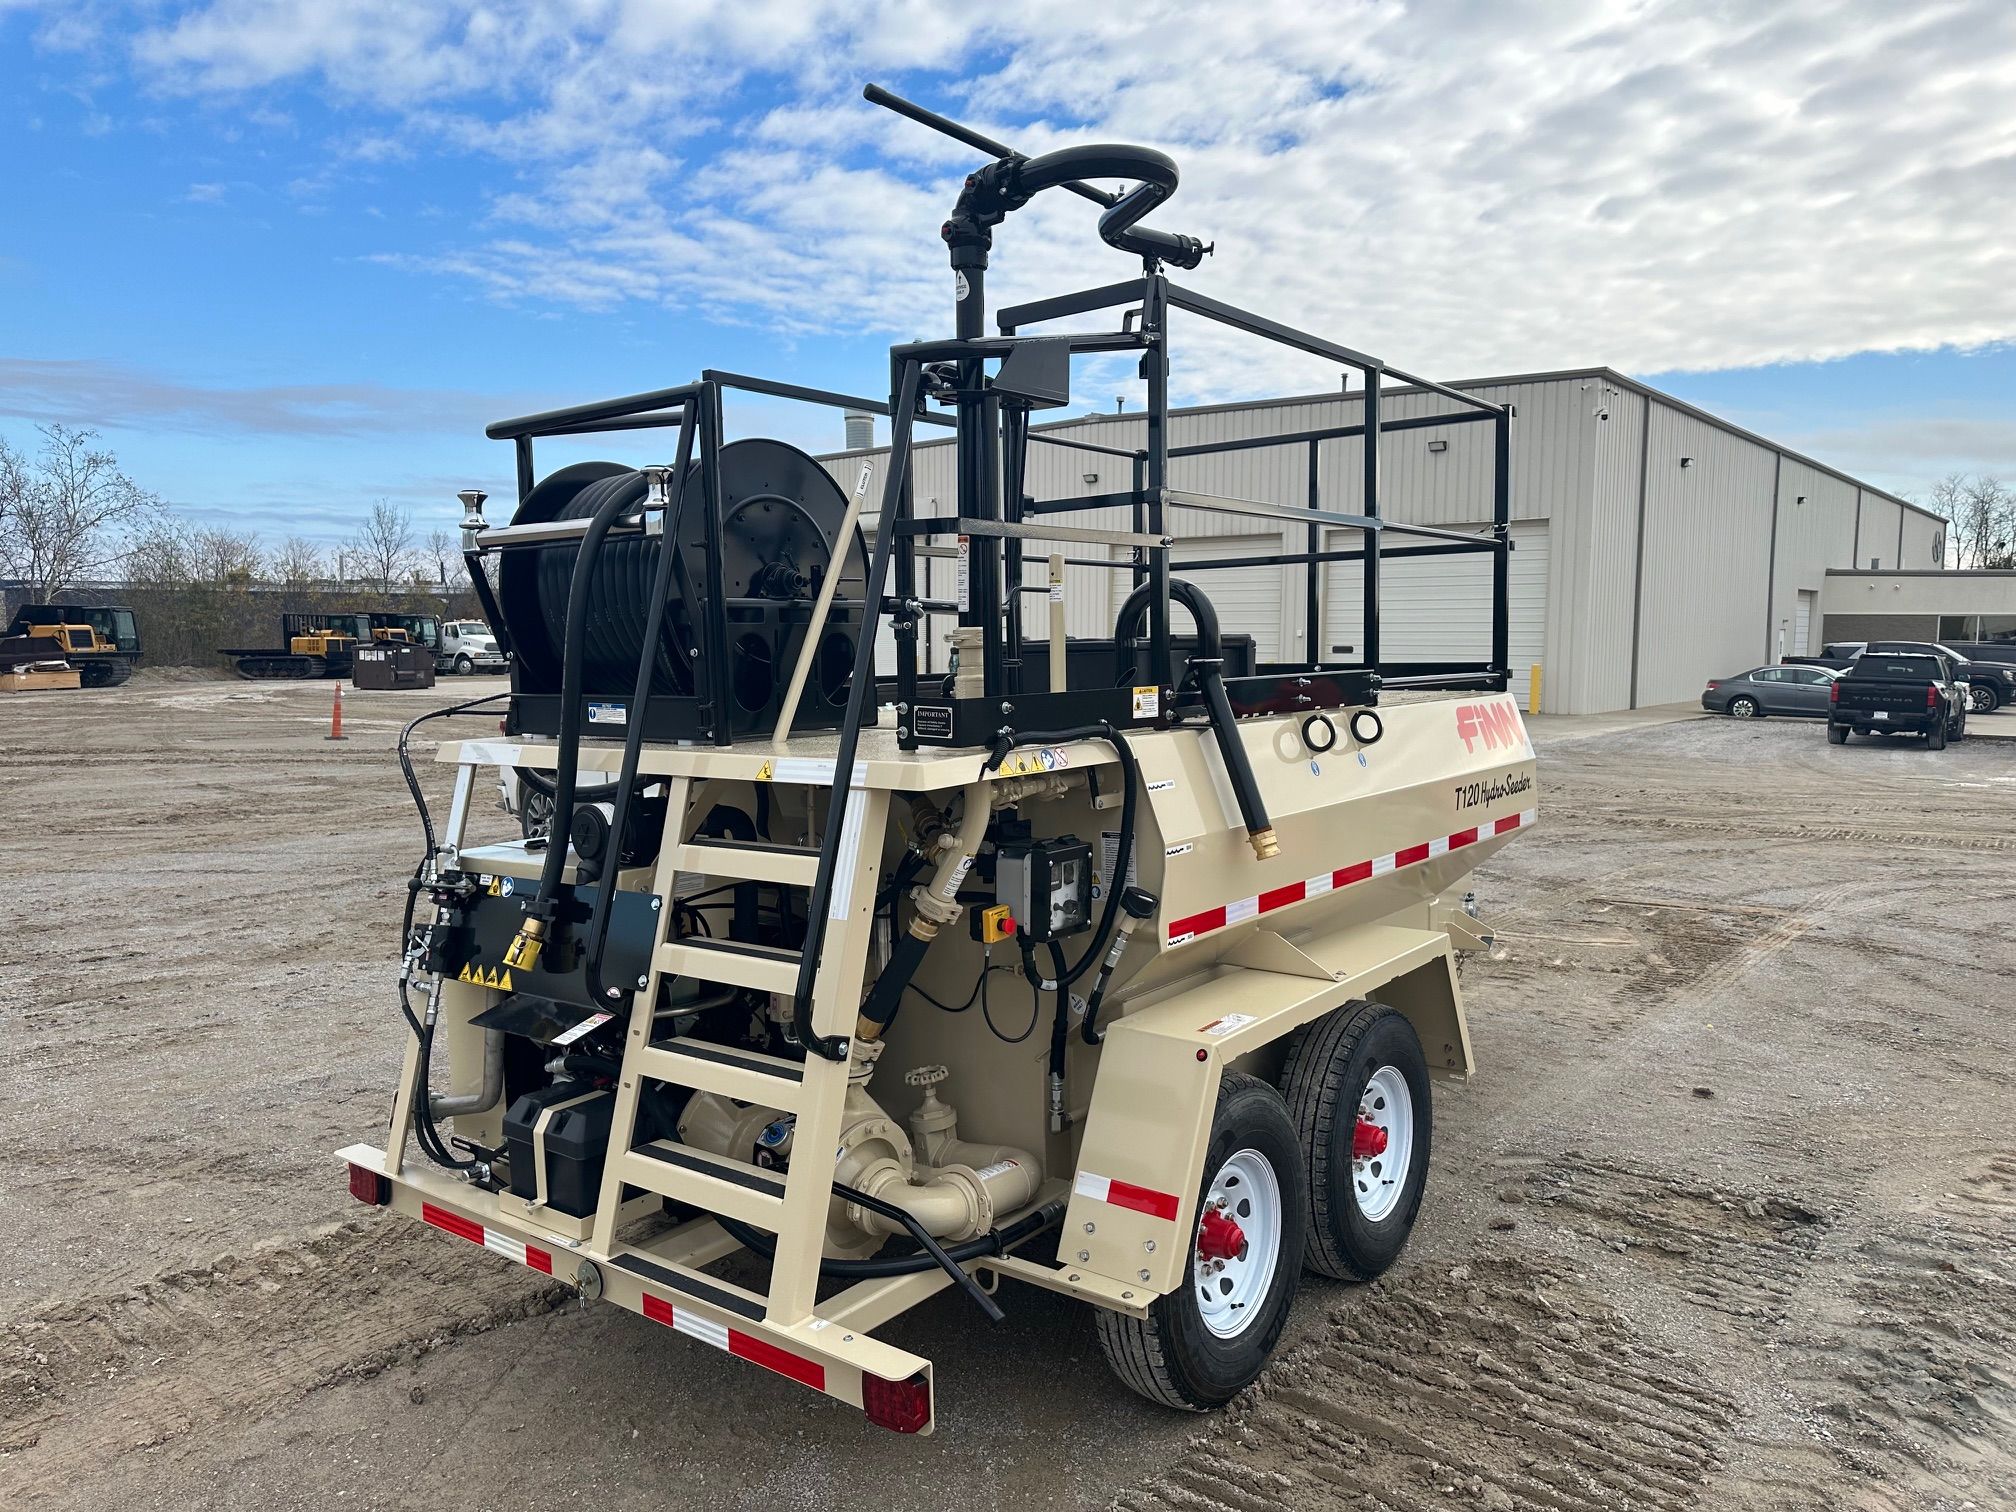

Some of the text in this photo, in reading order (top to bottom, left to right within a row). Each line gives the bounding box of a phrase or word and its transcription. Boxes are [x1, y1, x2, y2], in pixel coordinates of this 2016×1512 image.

[1852, 695, 1913, 703] TACOMA
[917, 710, 949, 718] IMPORTANT
[1456, 701, 1524, 754] FINN
[1455, 782, 1480, 811] T120
